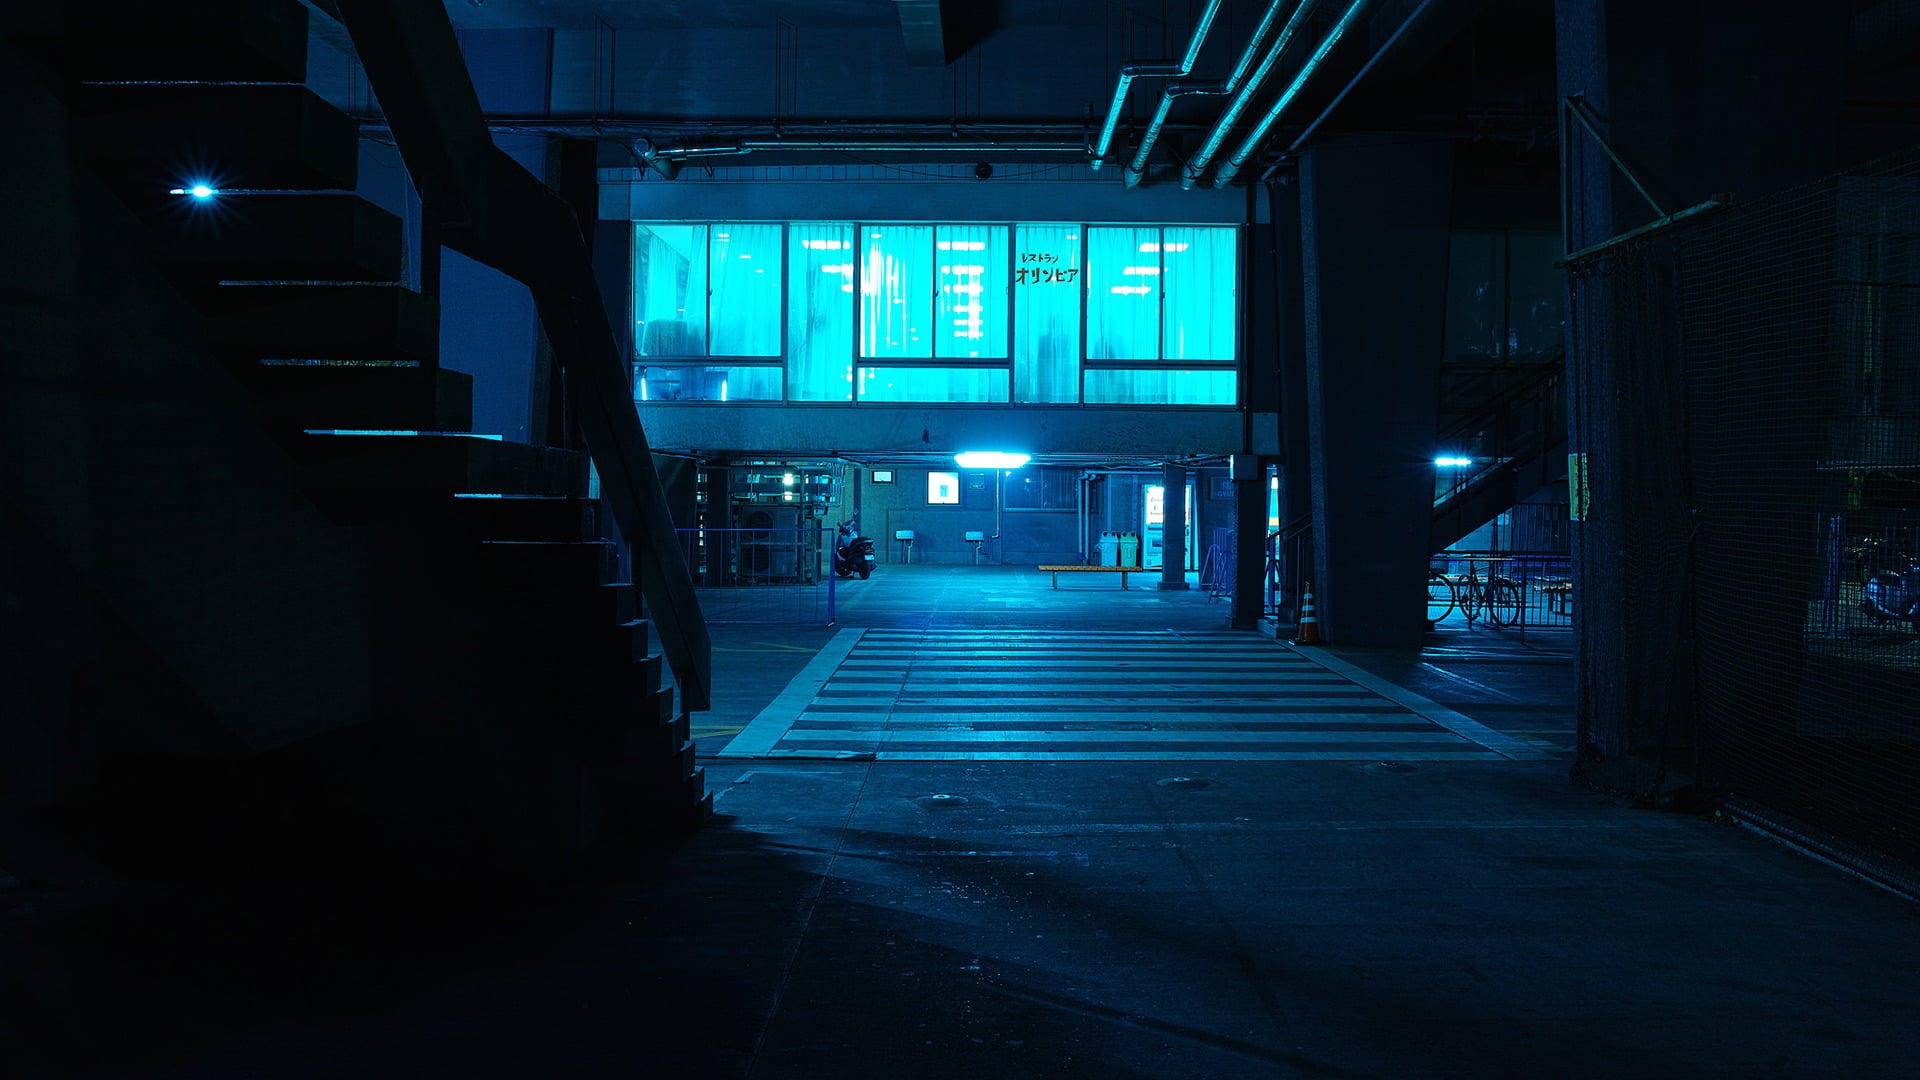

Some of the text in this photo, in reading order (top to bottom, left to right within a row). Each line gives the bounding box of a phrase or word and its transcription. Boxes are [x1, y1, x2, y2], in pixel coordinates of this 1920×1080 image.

[1021, 252, 1059, 264] レストラン
[1016, 267, 1079, 285] オリンピア
